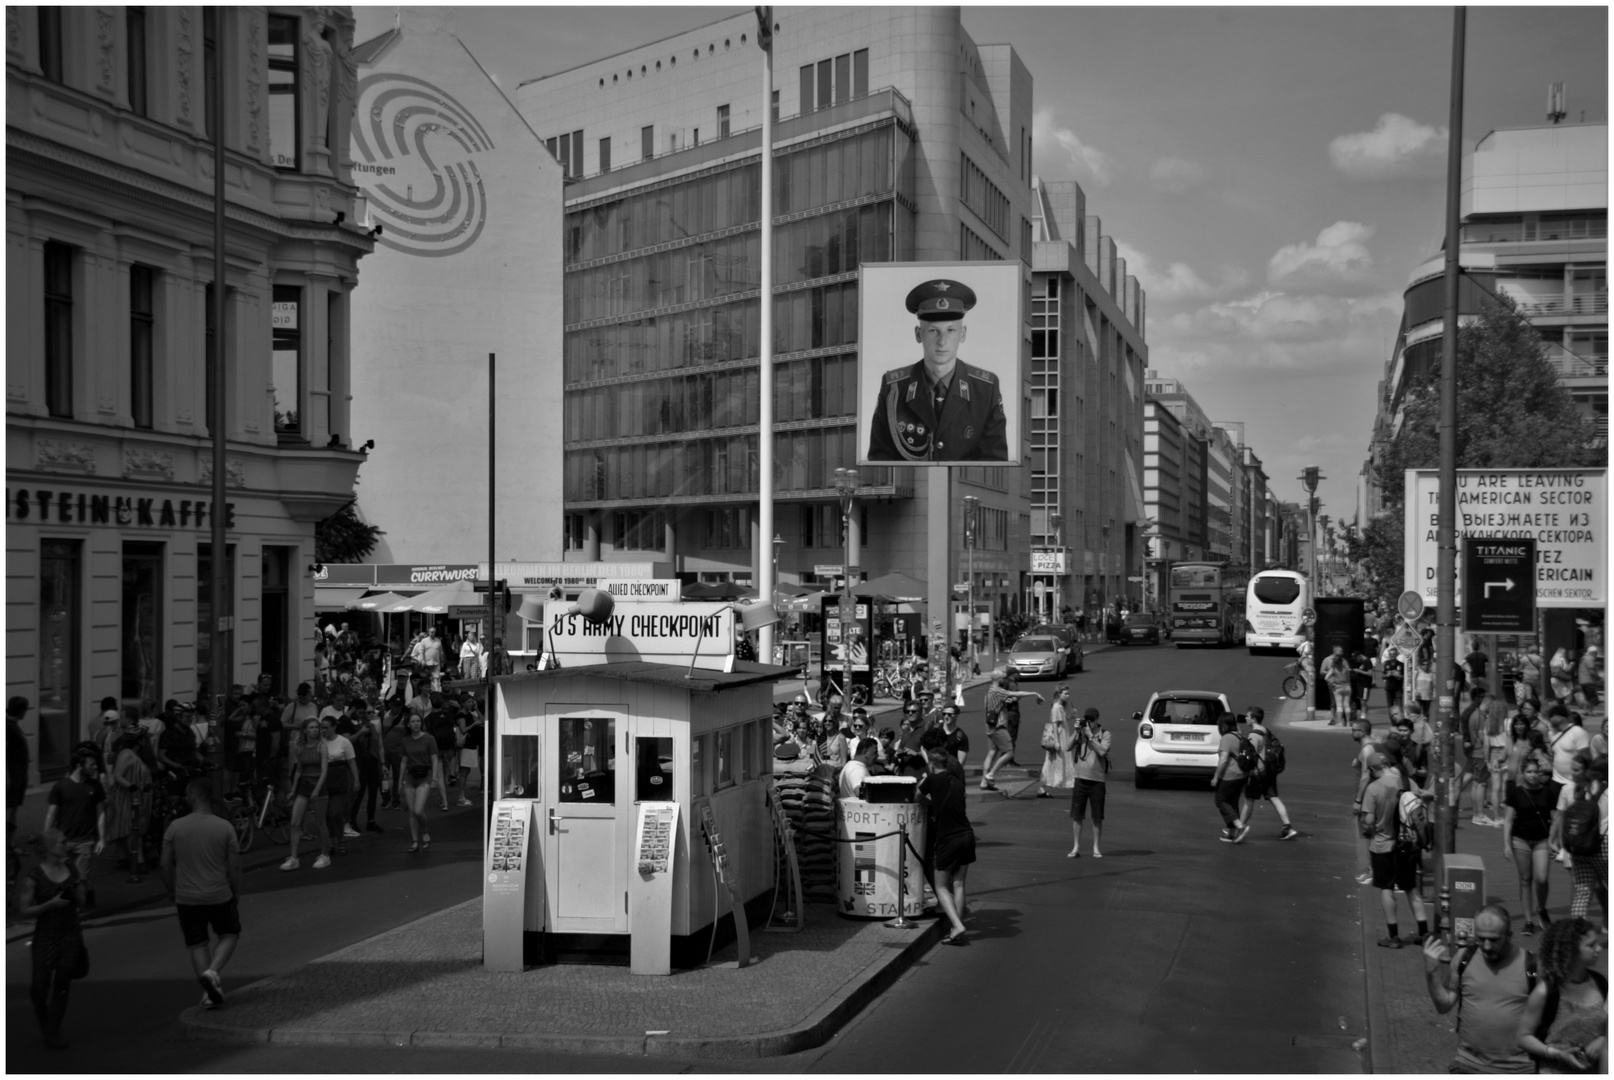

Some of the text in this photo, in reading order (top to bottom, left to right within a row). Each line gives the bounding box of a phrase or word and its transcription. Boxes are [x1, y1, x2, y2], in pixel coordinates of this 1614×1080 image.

[353, 161, 396, 176] ftungen
[1477, 474, 1507, 488] ARE
[1518, 473, 1585, 488] LEAVING
[1459, 491, 1531, 505] AMERICAN
[1540, 491, 1594, 505] SECTOR
[138, 497, 236, 529] KAFFE
[1430, 513, 1590, 526] В ВЫЕЗЖАЕТЕ ИЗ
[1538, 530, 1593, 543] СЕКТОРА
[1477, 546, 1525, 555] TITANIC
[410, 568, 478, 583] CURRYWURST
[480, 564, 546, 577] WLLKOMMEN
[1537, 565, 1593, 580] ÉRICAIN
[608, 583, 669, 596] ALLIED CHECKPOINT
[1564, 588, 1593, 598] SEKTOR
[583, 614, 625, 637] ARMY
[631, 614, 721, 637] CHECKPOINT
[867, 903, 922, 915] STAMP
